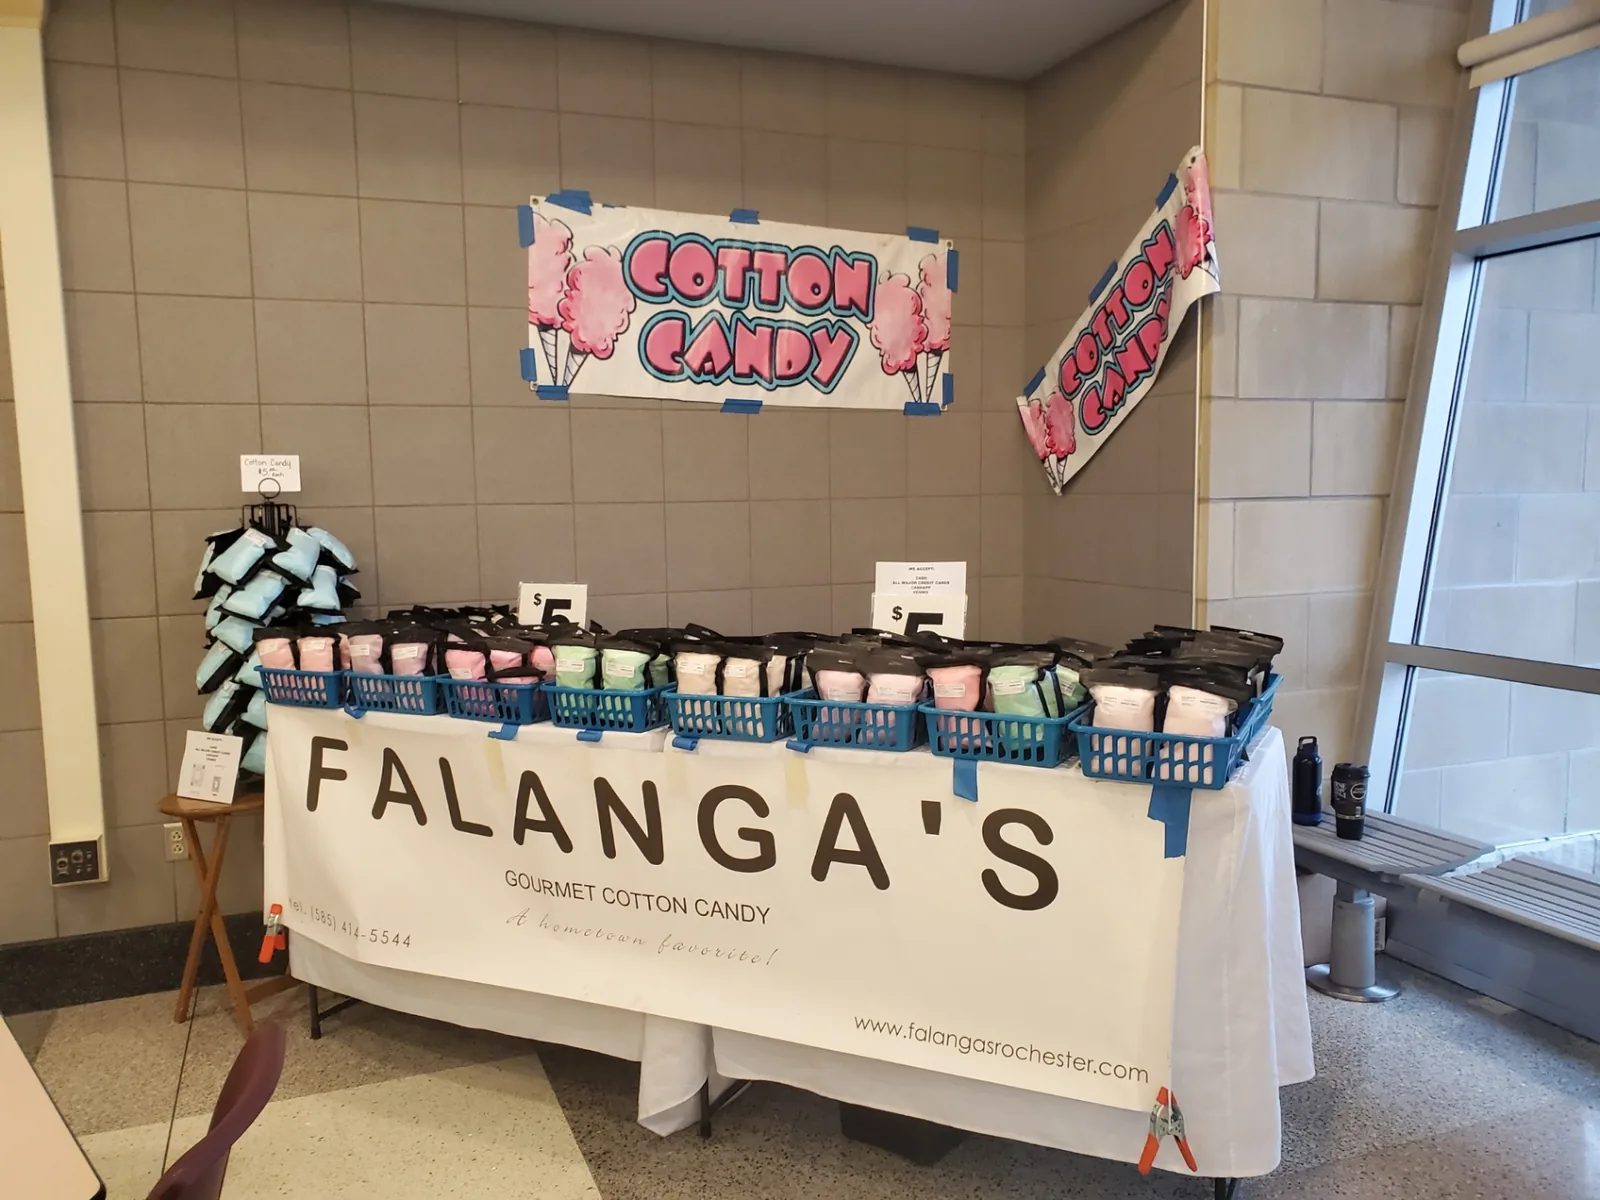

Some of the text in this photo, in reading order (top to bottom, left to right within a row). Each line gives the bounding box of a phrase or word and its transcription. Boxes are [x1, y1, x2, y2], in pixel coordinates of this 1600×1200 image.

[622, 230, 877, 323] COTTON
[1059, 218, 1175, 400] COTTON
[638, 309, 859, 394] CANDY
[244, 458, 292, 469] Cotton Candy
[306, 735, 1059, 911] FALANGA'S
[310, 906, 336, 932] (585)
[341, 922, 411, 948] 414-5544
[505, 870, 771, 924] GOURMET COTTON CANDY
[506, 907, 779, 966] A hometown favorite!
[854, 1016, 1149, 1083] www.falangasrochester.com
